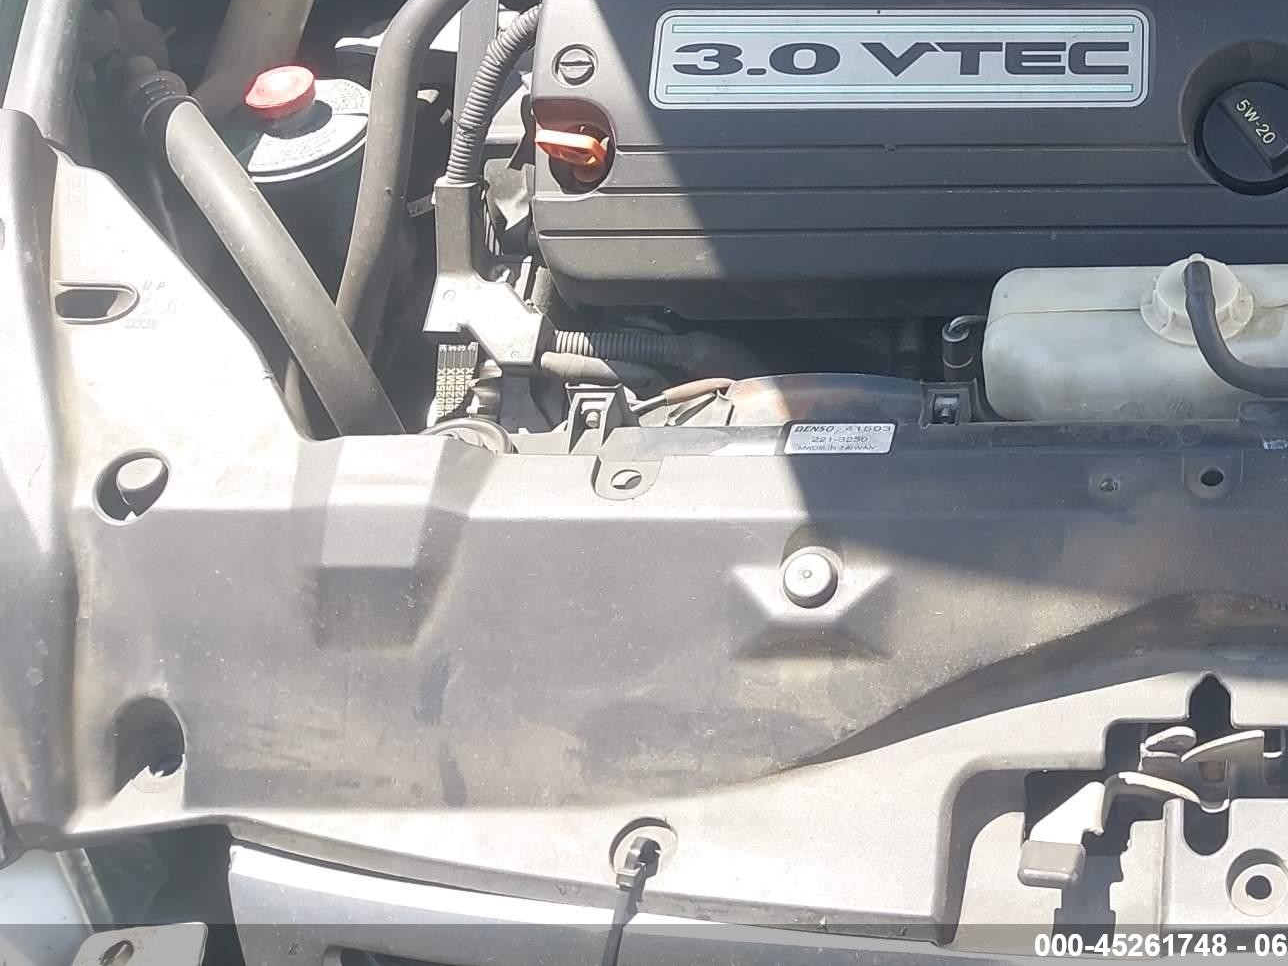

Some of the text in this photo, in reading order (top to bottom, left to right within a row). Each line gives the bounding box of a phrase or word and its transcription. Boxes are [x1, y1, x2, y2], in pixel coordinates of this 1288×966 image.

[673, 41, 1129, 77] 3.0 VTEC
[1236, 99, 1276, 144] 5W-20
